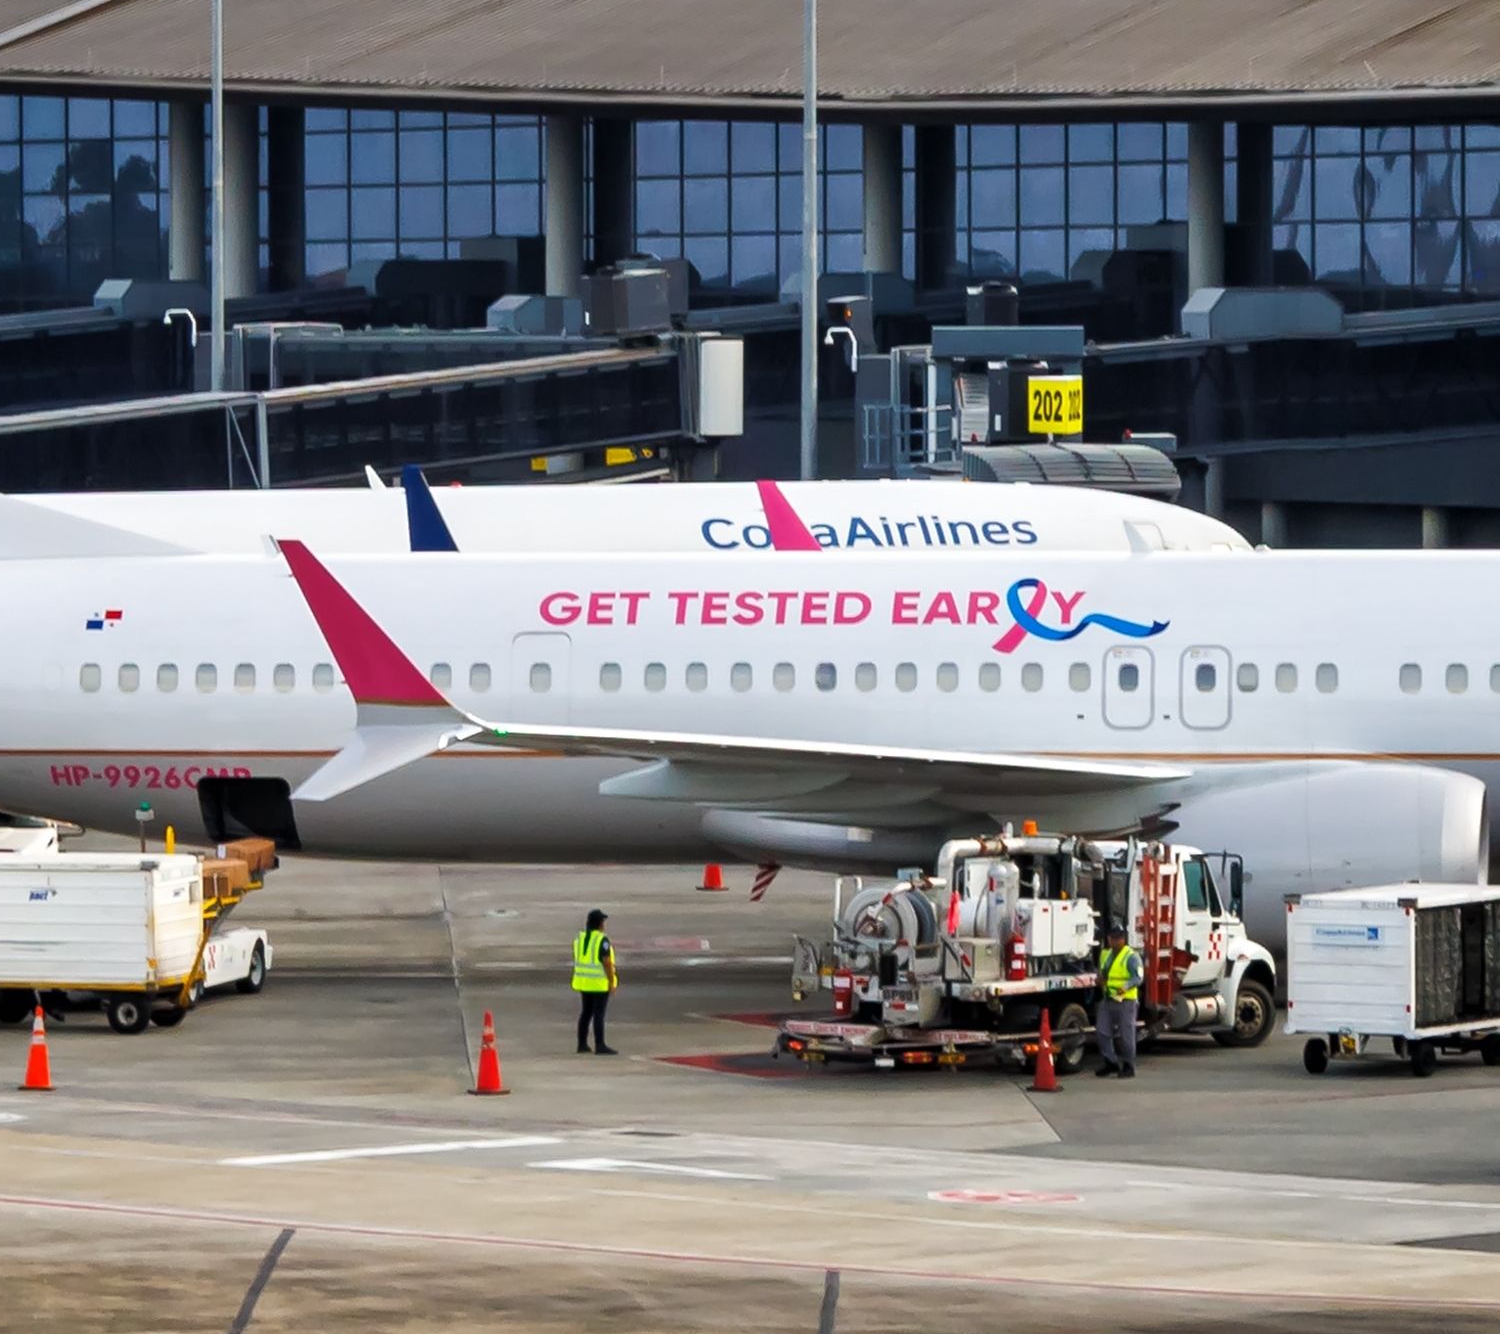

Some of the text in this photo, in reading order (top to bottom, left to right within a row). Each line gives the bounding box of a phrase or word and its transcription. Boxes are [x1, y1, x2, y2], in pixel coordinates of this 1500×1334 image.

[1033, 389, 1063, 422] 202
[700, 515, 1038, 550] CoaAirlines
[539, 590, 649, 626] GET
[667, 590, 873, 626] TESTED
